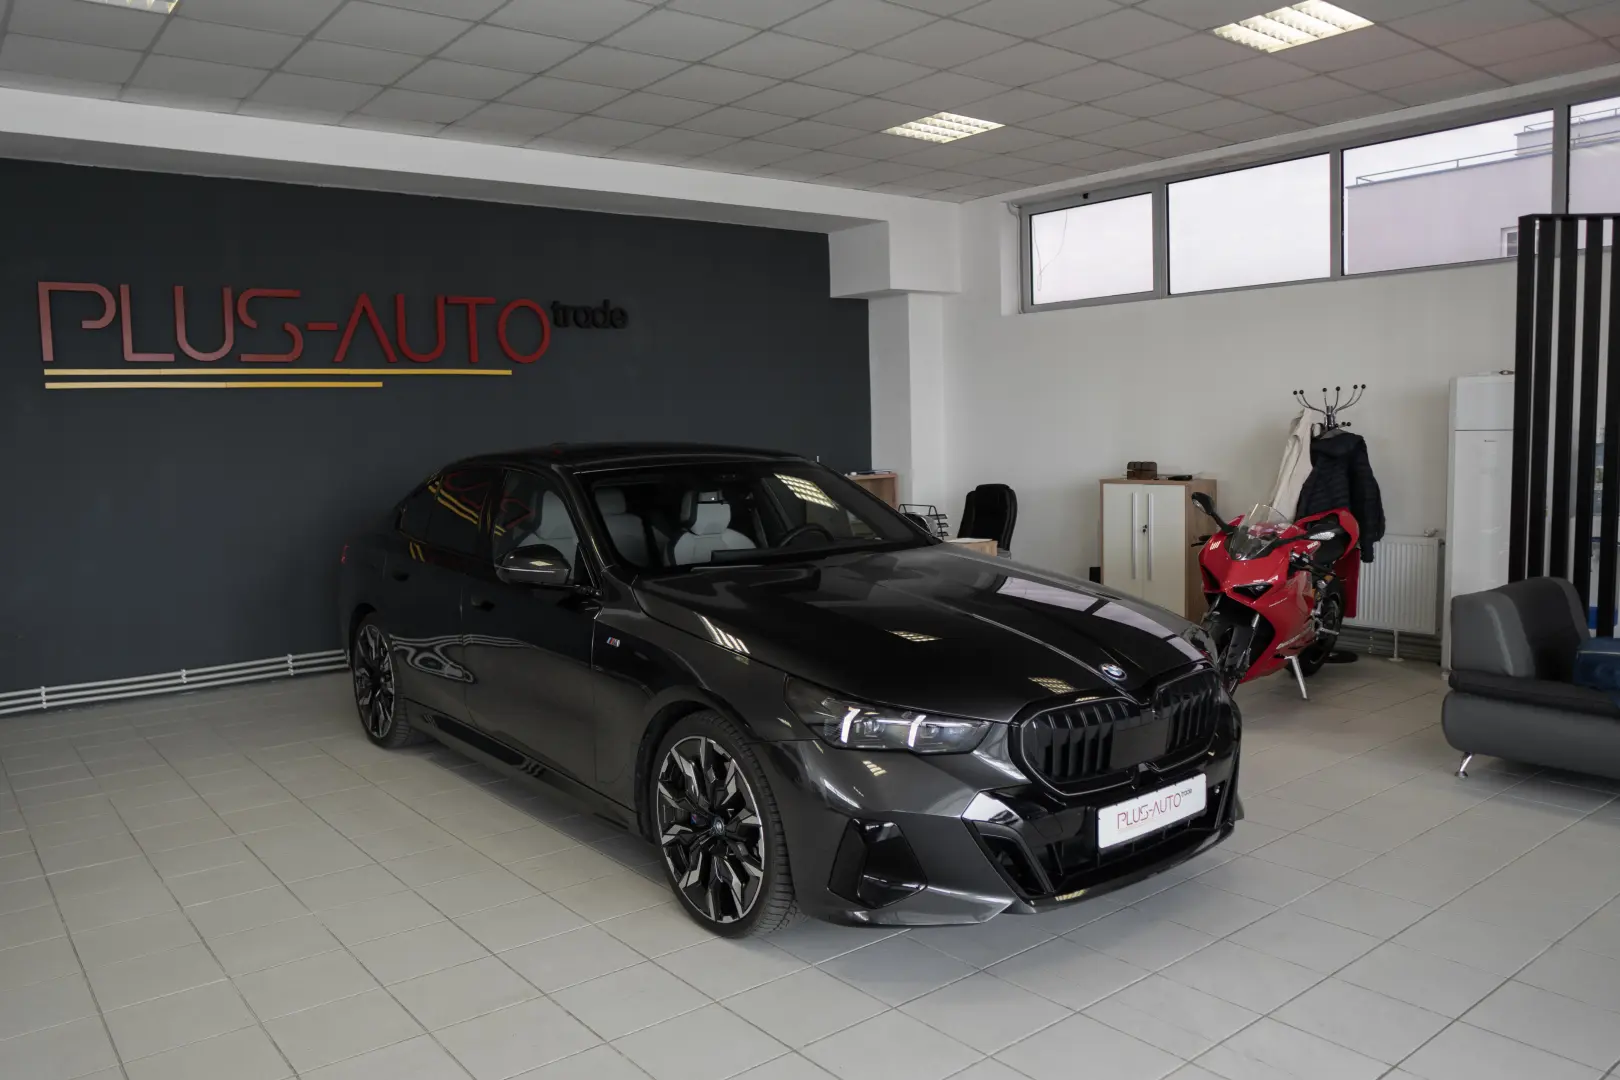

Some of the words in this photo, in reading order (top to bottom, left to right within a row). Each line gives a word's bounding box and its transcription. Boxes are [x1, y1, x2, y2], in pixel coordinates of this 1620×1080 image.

[38, 281, 551, 363] PLUS-AUTO
[551, 299, 629, 329] trade
[1117, 792, 1181, 829] PLUS-AUTO
